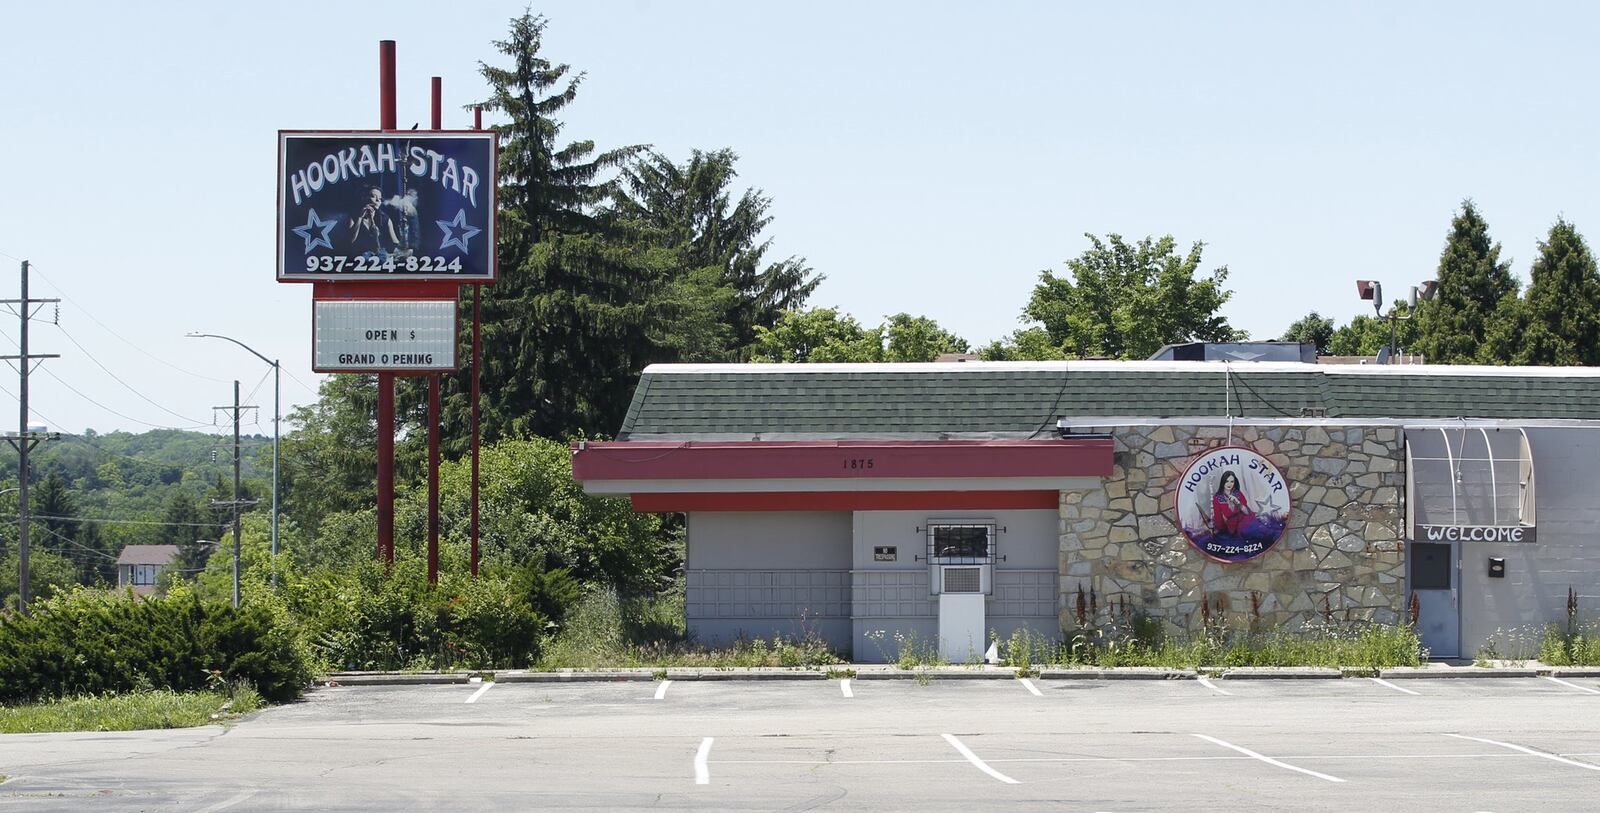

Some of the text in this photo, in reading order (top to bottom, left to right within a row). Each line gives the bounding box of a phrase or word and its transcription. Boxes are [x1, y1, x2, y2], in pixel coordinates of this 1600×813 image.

[291, 143, 479, 208] HOOKAH STAR
[306, 255, 462, 273] 937-224-8224
[365, 330, 398, 341] OPEN
[338, 353, 376, 365] GRAND
[843, 458, 873, 469] 1875
[1184, 454, 1283, 493] HOOKAH STAR
[1422, 525, 1524, 542] WELCOME
[1206, 542, 1263, 554] 937-224-8224
